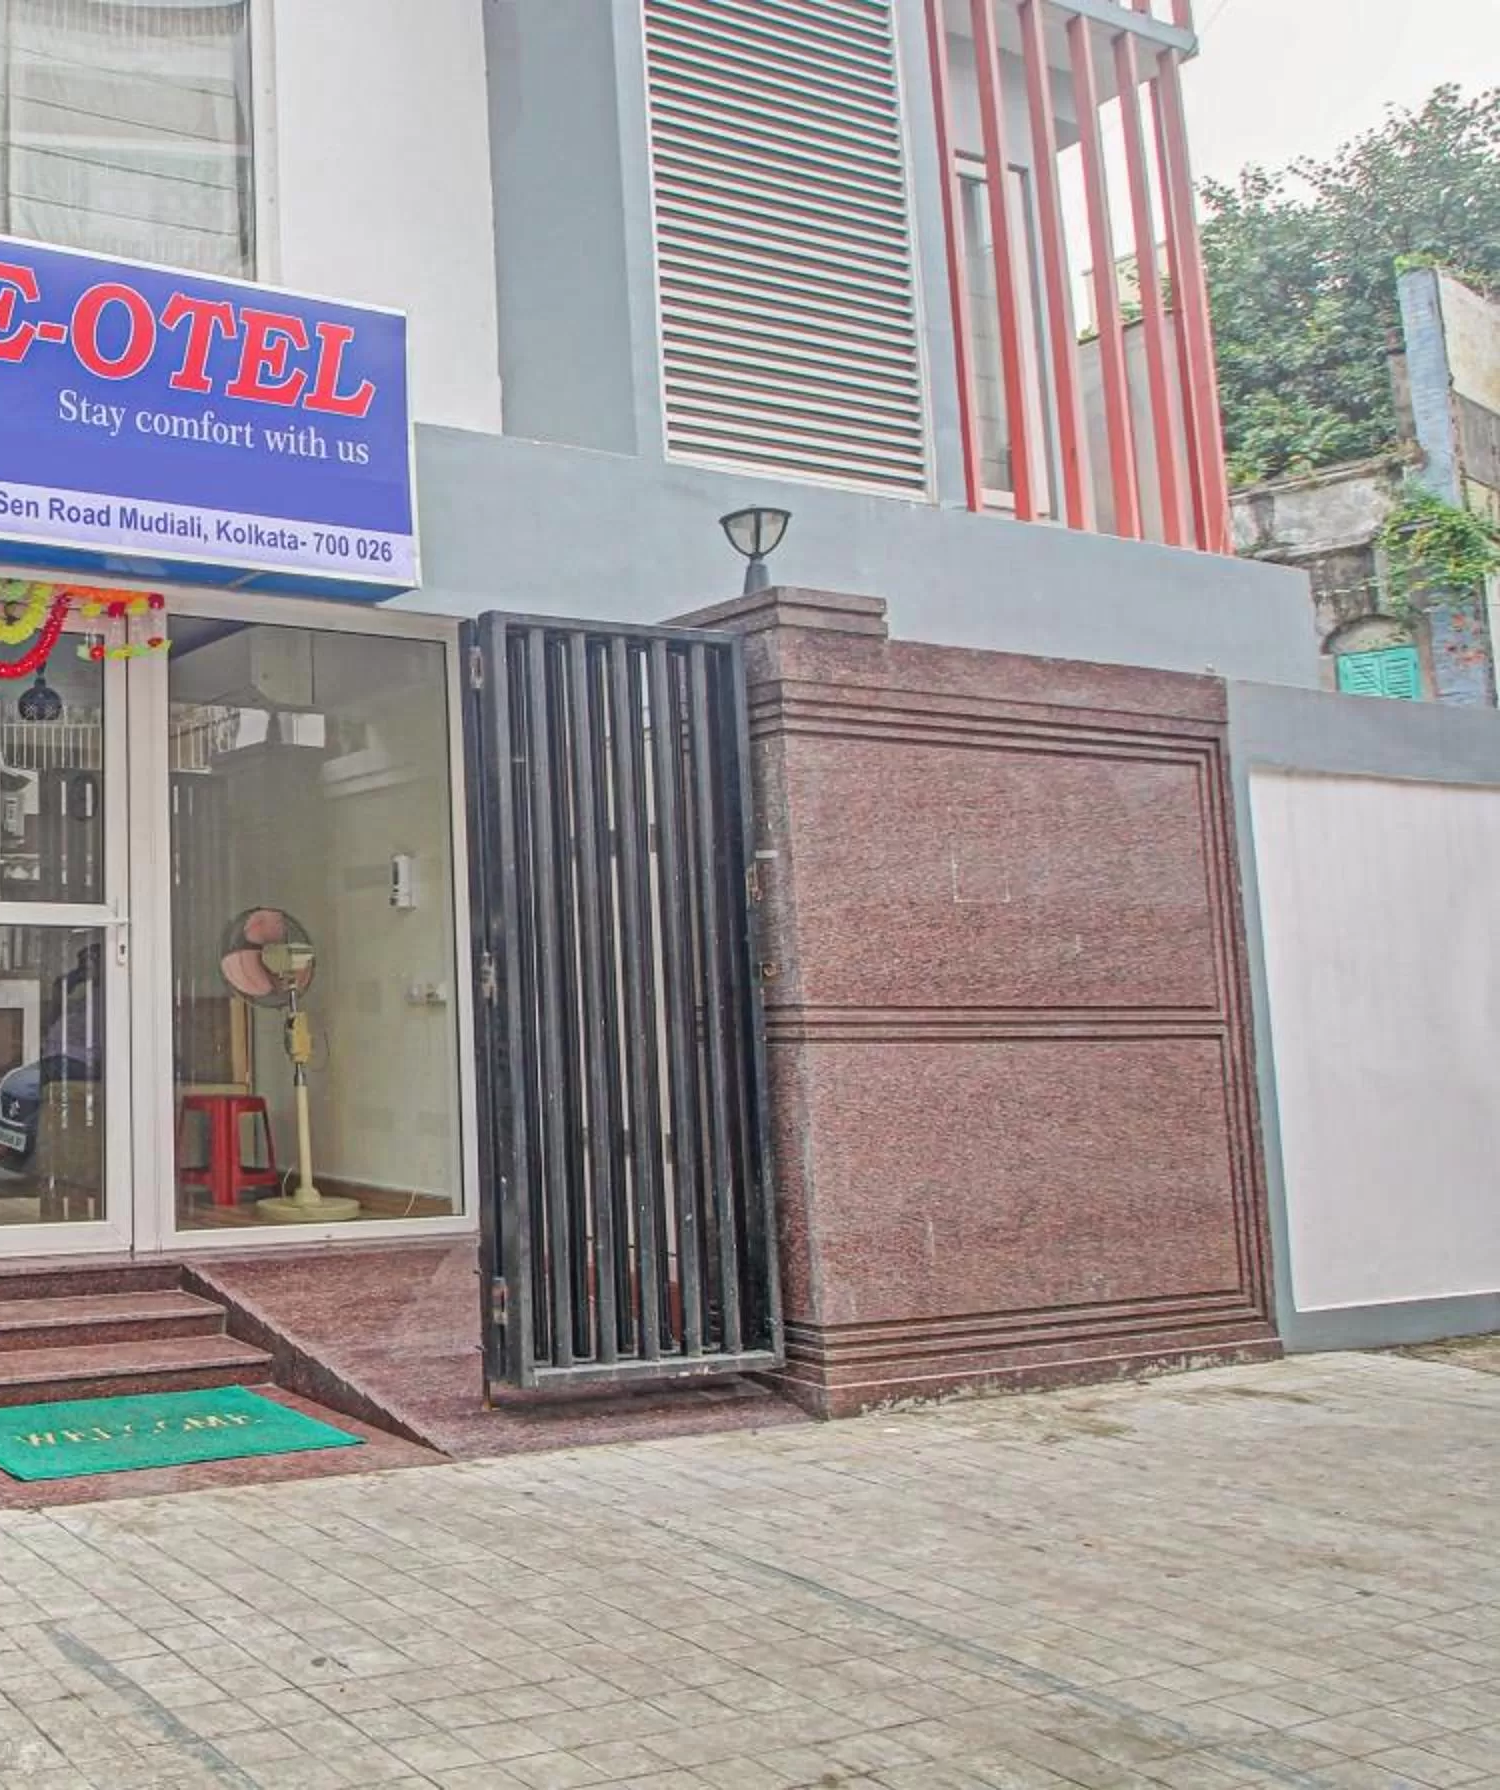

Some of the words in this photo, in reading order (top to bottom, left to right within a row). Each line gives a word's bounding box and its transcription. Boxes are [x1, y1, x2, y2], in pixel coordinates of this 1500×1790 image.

[58, 389, 126, 437] Stay
[135, 410, 254, 449] comfort
[263, 425, 326, 459] with
[337, 439, 370, 465] us
[49, 497, 111, 527] Road
[119, 505, 209, 543] Mudiali,
[216, 518, 307, 551] Kolkata-
[313, 531, 349, 557] 700
[356, 537, 393, 562] 026
